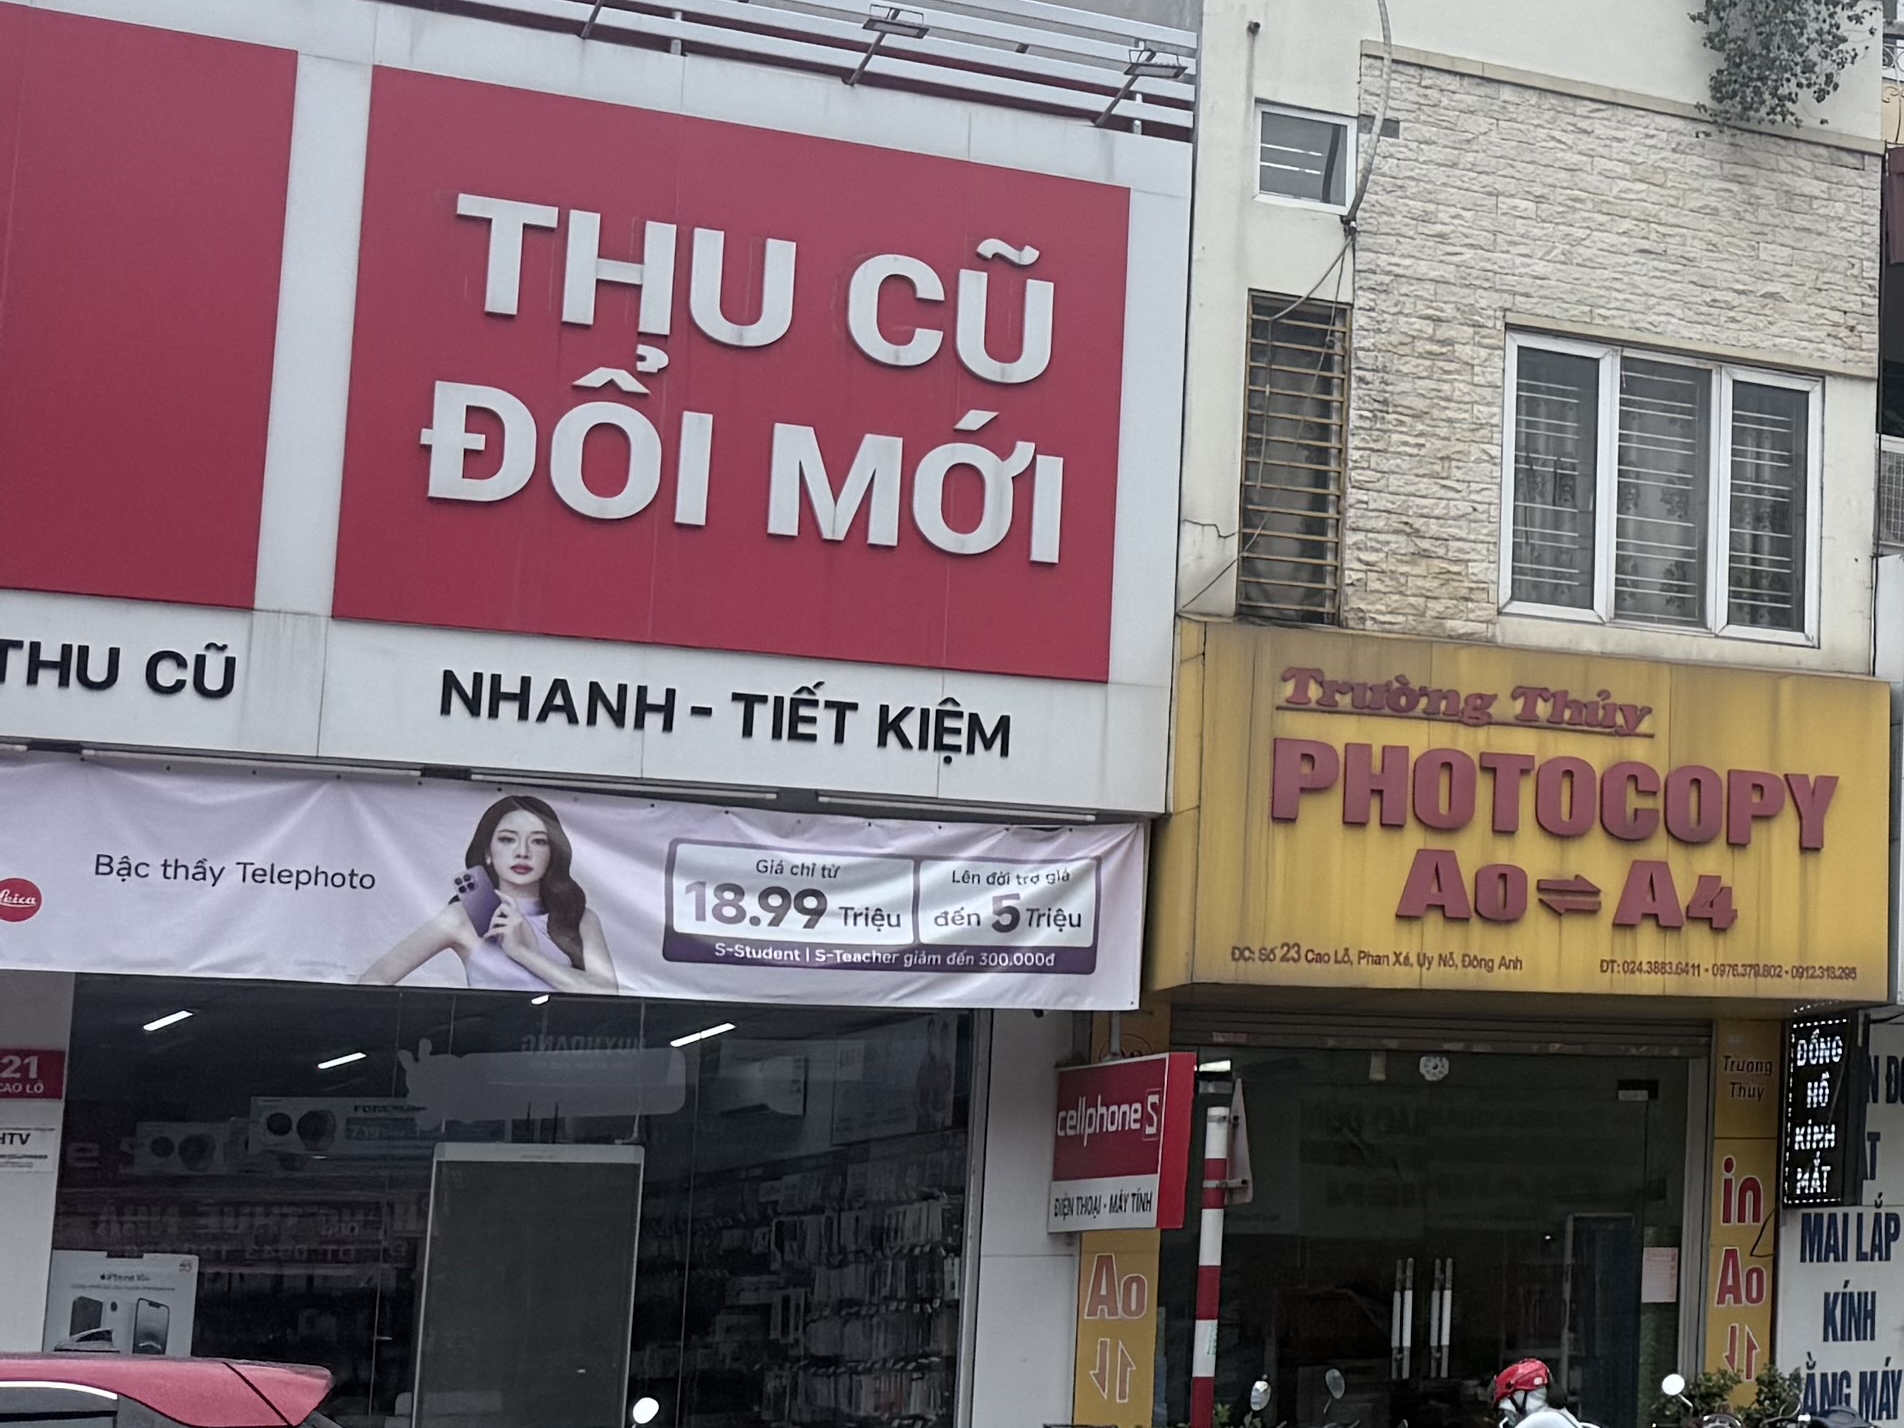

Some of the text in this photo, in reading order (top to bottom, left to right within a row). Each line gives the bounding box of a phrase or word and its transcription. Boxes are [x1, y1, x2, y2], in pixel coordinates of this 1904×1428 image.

[456, 194, 1055, 384] THU CŨ
[419, 345, 1065, 564] ĐỔI MỚI
[0, 638, 236, 699] THU CŨ
[440, 669, 1013, 764] NHANH TIẾT KIỆM
[1281, 666, 1655, 736] Trường Thúy
[1270, 737, 1840, 851] PHOTOCOPY
[94, 854, 375, 890] Bậc thầy Telephoto
[755, 859, 785, 875] Giá
[790, 860, 812, 877] chỉ
[951, 870, 981, 886] Lên
[1612, 858, 1739, 930] A4
[684, 881, 901, 932] 18.99 Triệu
[933, 893, 1082, 933] đến 5 Triệu
[714, 942, 1055, 968] S-Student S-Teacher giảm đến 300.000đ
[1280, 943, 1301, 963] 23
[1305, 949, 1330, 964] Cao
[1357, 950, 1389, 967] Phan
[1498, 955, 1523, 971] Anh
[1, 1055, 39, 1079] 21
[1054, 1186, 1152, 1220] ĐIỆN THOẠI MÁY TÍNH
[1720, 1155, 1764, 1226] in
[1856, 1192, 1901, 1262] LẮP
[1823, 1280, 1876, 1342] KÍNH
[1858, 1357, 1903, 1421] MÁY
